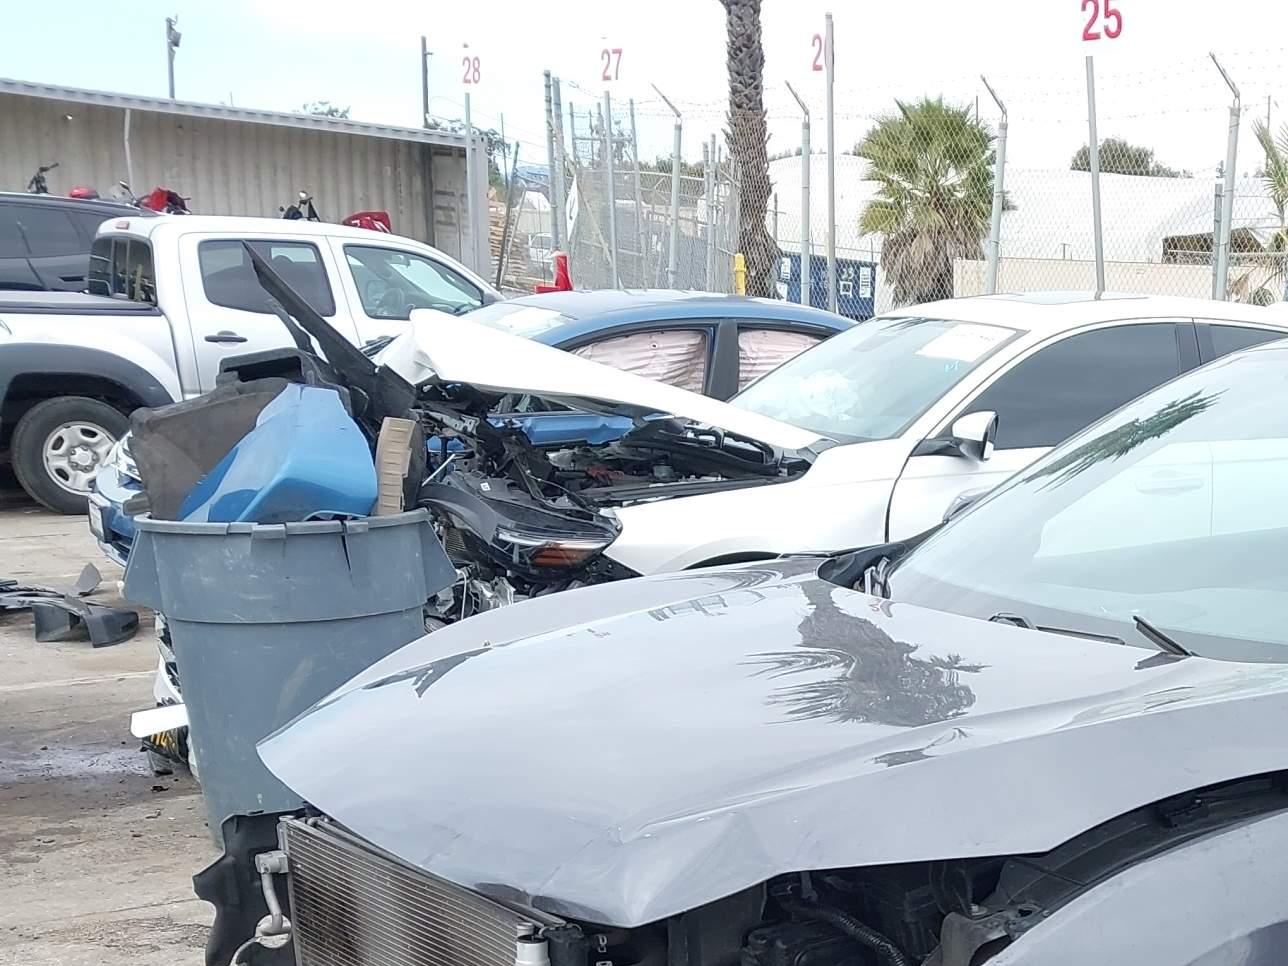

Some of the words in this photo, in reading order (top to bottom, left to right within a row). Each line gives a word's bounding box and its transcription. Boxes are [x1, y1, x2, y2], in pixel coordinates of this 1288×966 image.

[1081, 0, 1122, 41] 25
[601, 48, 622, 81] 27
[811, 33, 829, 71] 2
[462, 56, 481, 84] 28
